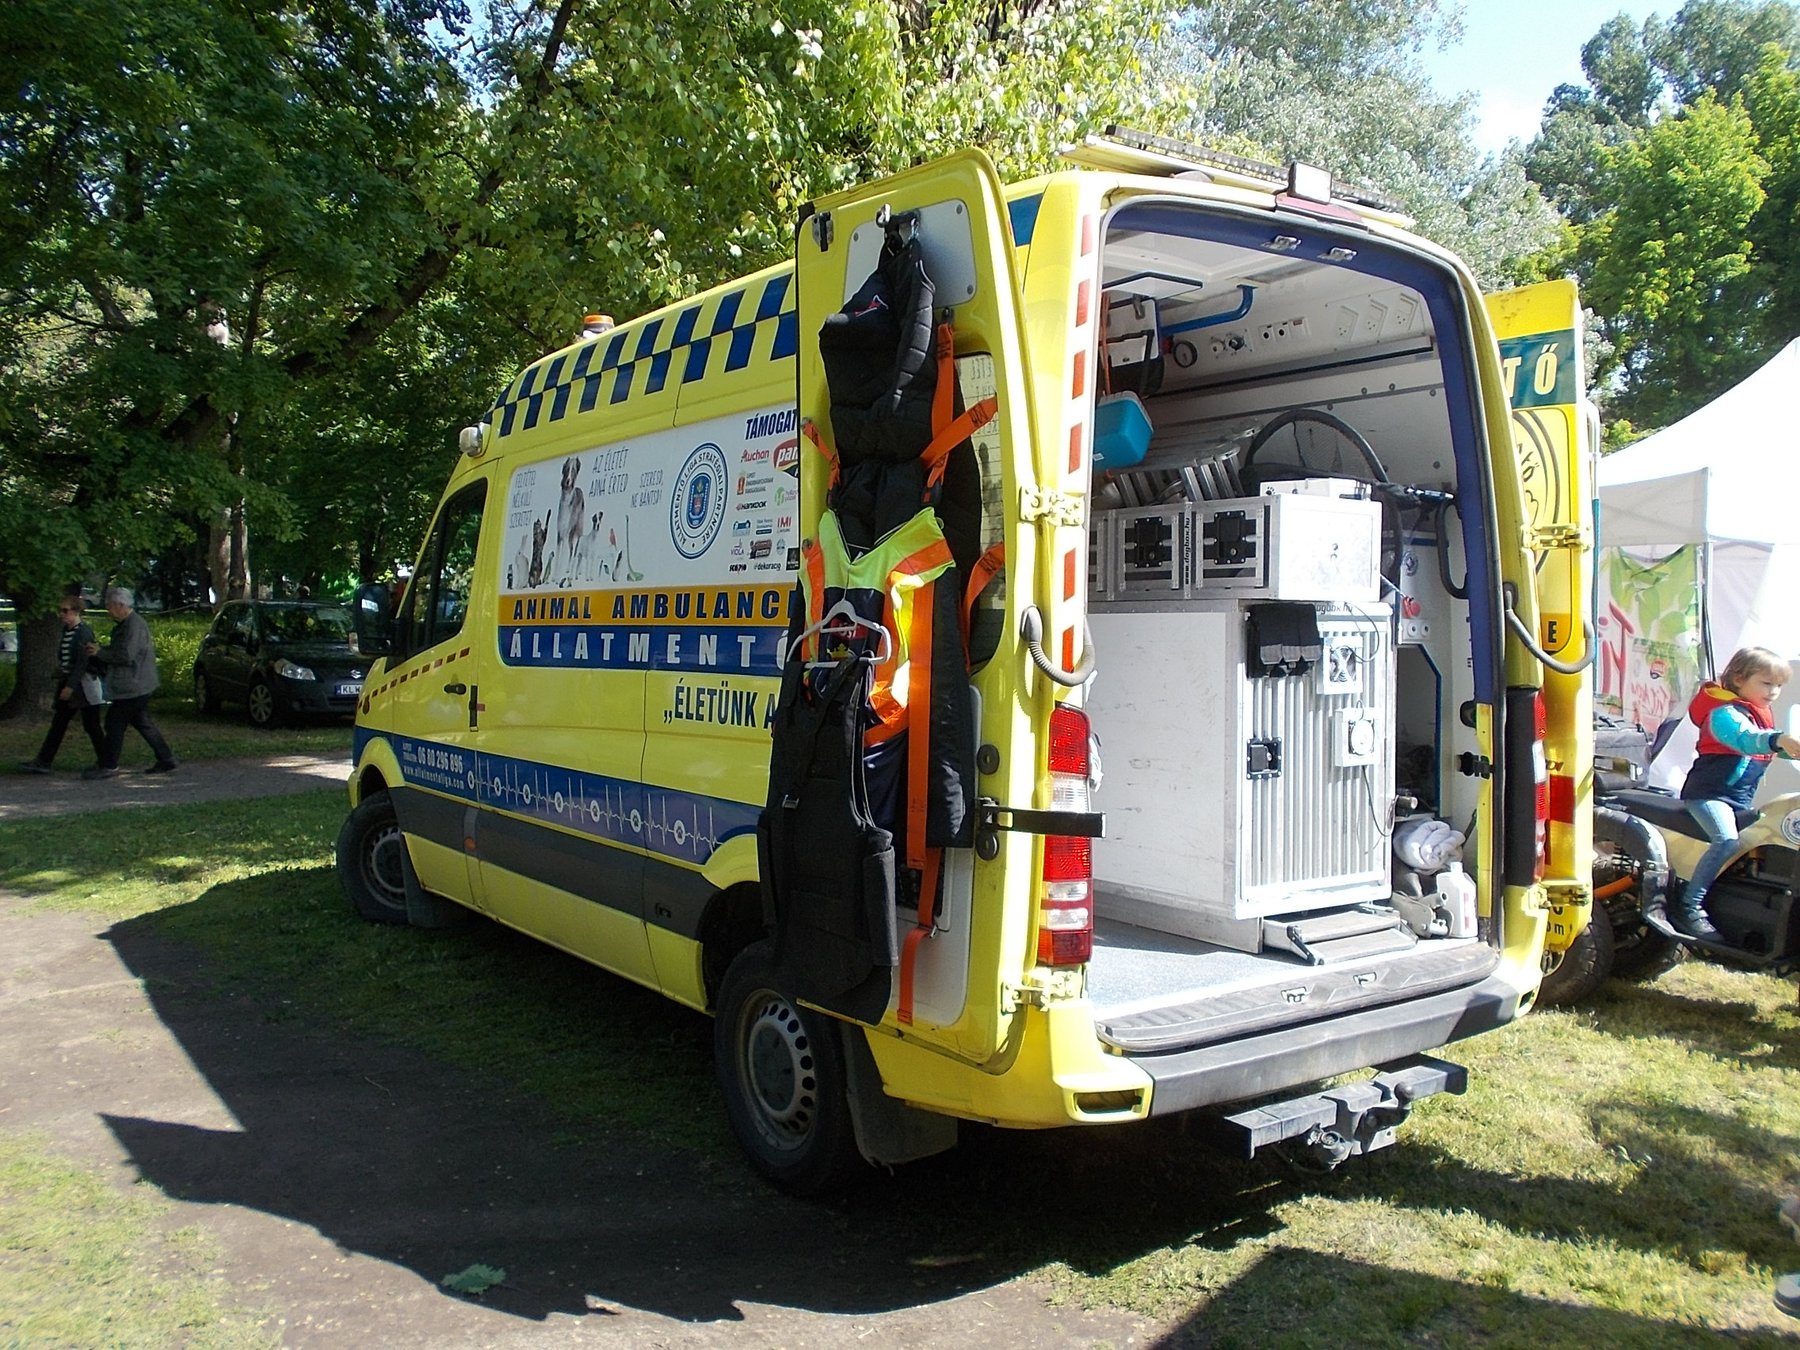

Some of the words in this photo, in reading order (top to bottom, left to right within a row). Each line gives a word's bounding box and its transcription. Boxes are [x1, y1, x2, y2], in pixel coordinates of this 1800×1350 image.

[740, 449, 770, 463] Auchan
[513, 596, 592, 620] ANIMAL
[1548, 621, 1557, 643] E
[418, 746, 426, 765] 06
[427, 748, 435, 767] 80
[436, 750, 449, 770] 296
[450, 753, 463, 774] 896
